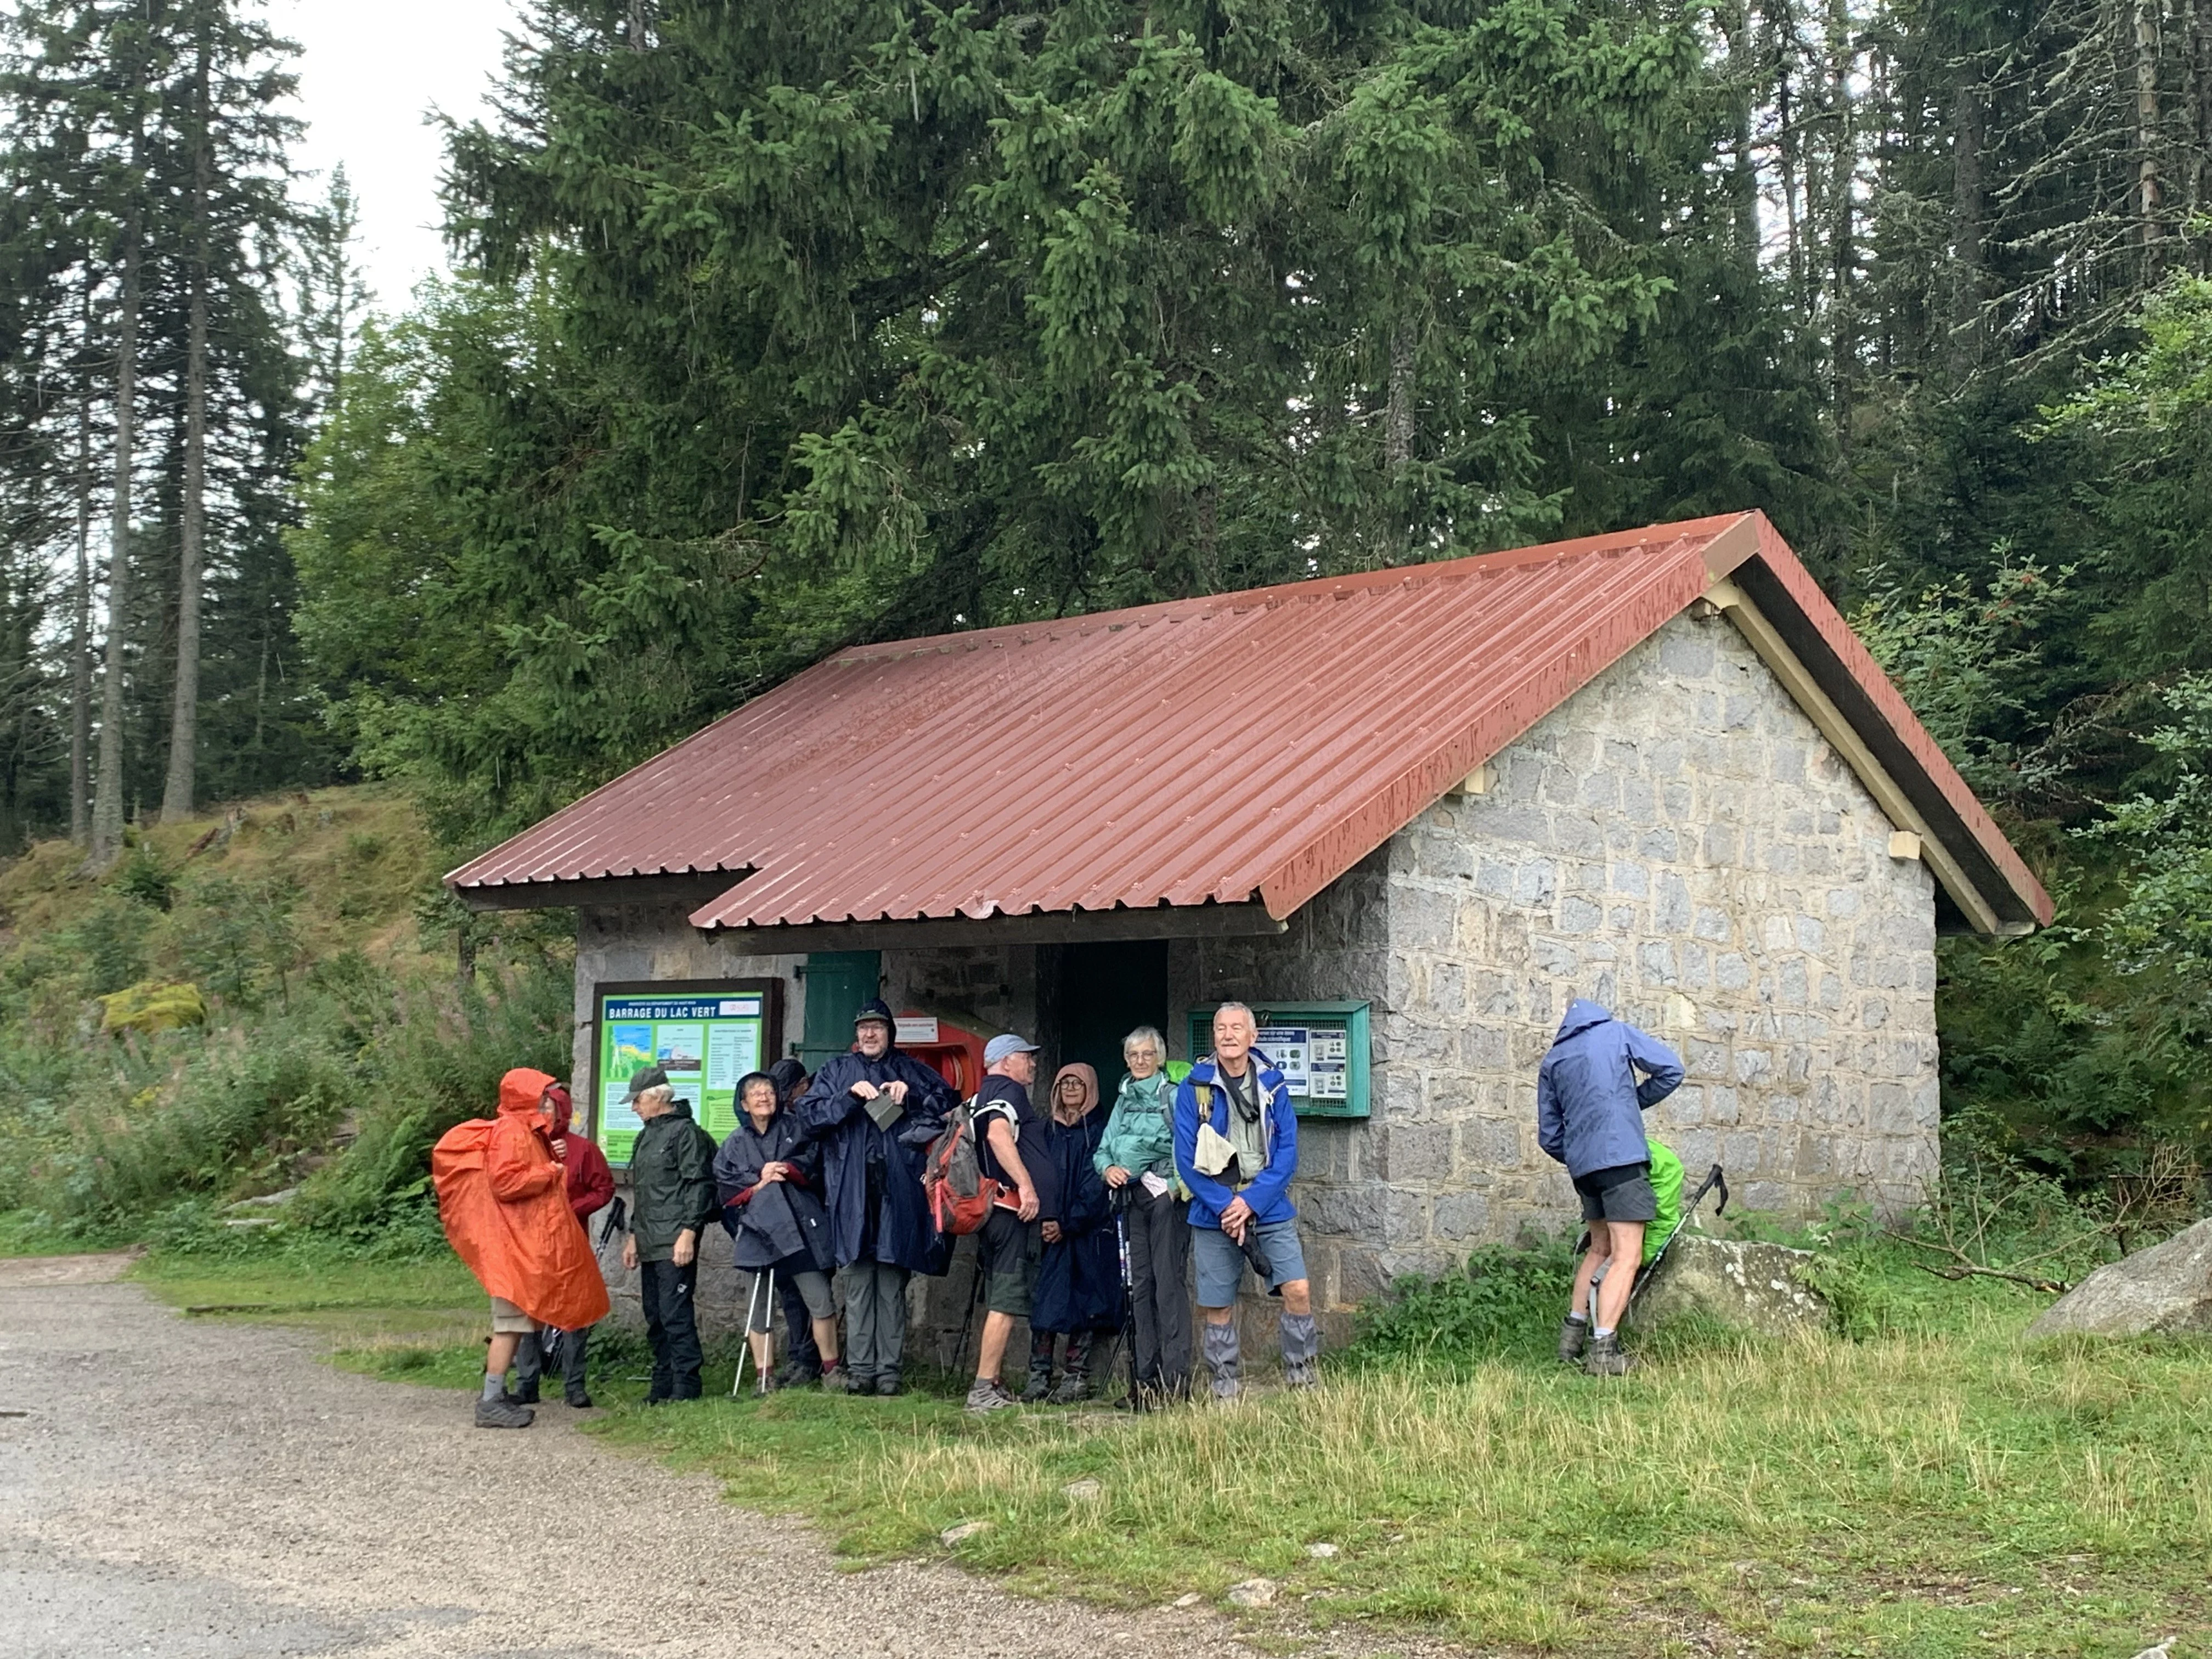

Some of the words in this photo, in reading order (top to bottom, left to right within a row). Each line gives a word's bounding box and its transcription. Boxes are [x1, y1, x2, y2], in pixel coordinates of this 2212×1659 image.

[610, 1008, 651, 1018] BARRAGE
[655, 1008, 667, 1018] DU
[670, 1007, 688, 1017] LAC
[691, 1007, 715, 1017] VERT
